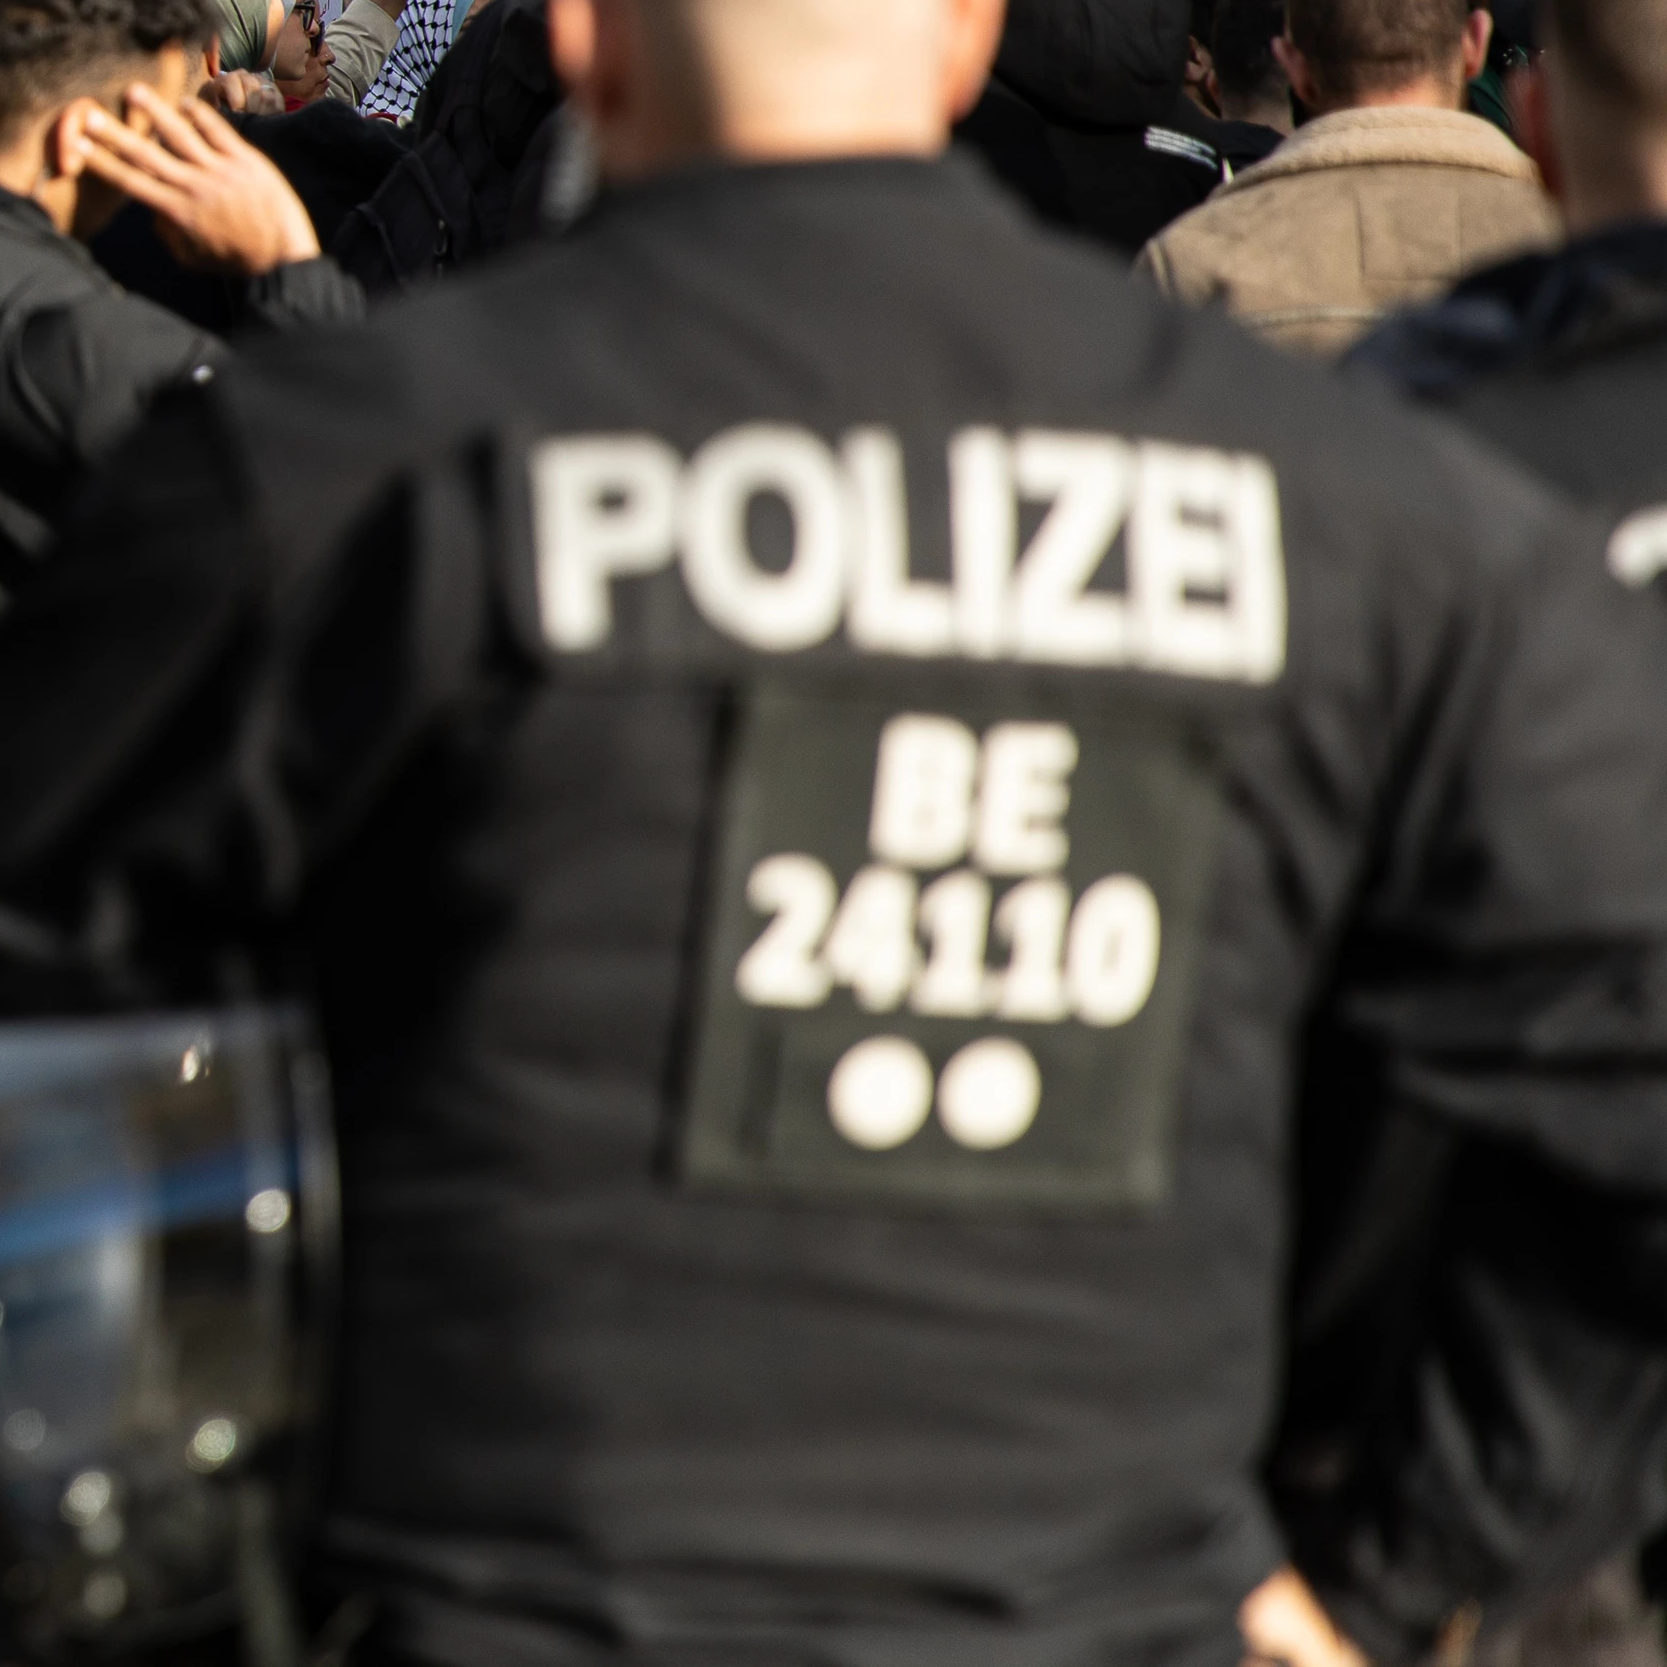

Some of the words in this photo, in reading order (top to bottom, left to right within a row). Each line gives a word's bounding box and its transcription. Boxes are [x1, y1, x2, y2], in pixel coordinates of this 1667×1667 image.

[529, 419, 1289, 686] POLIZEI
[870, 710, 1078, 877] BE
[735, 852, 1163, 1028] 24110
